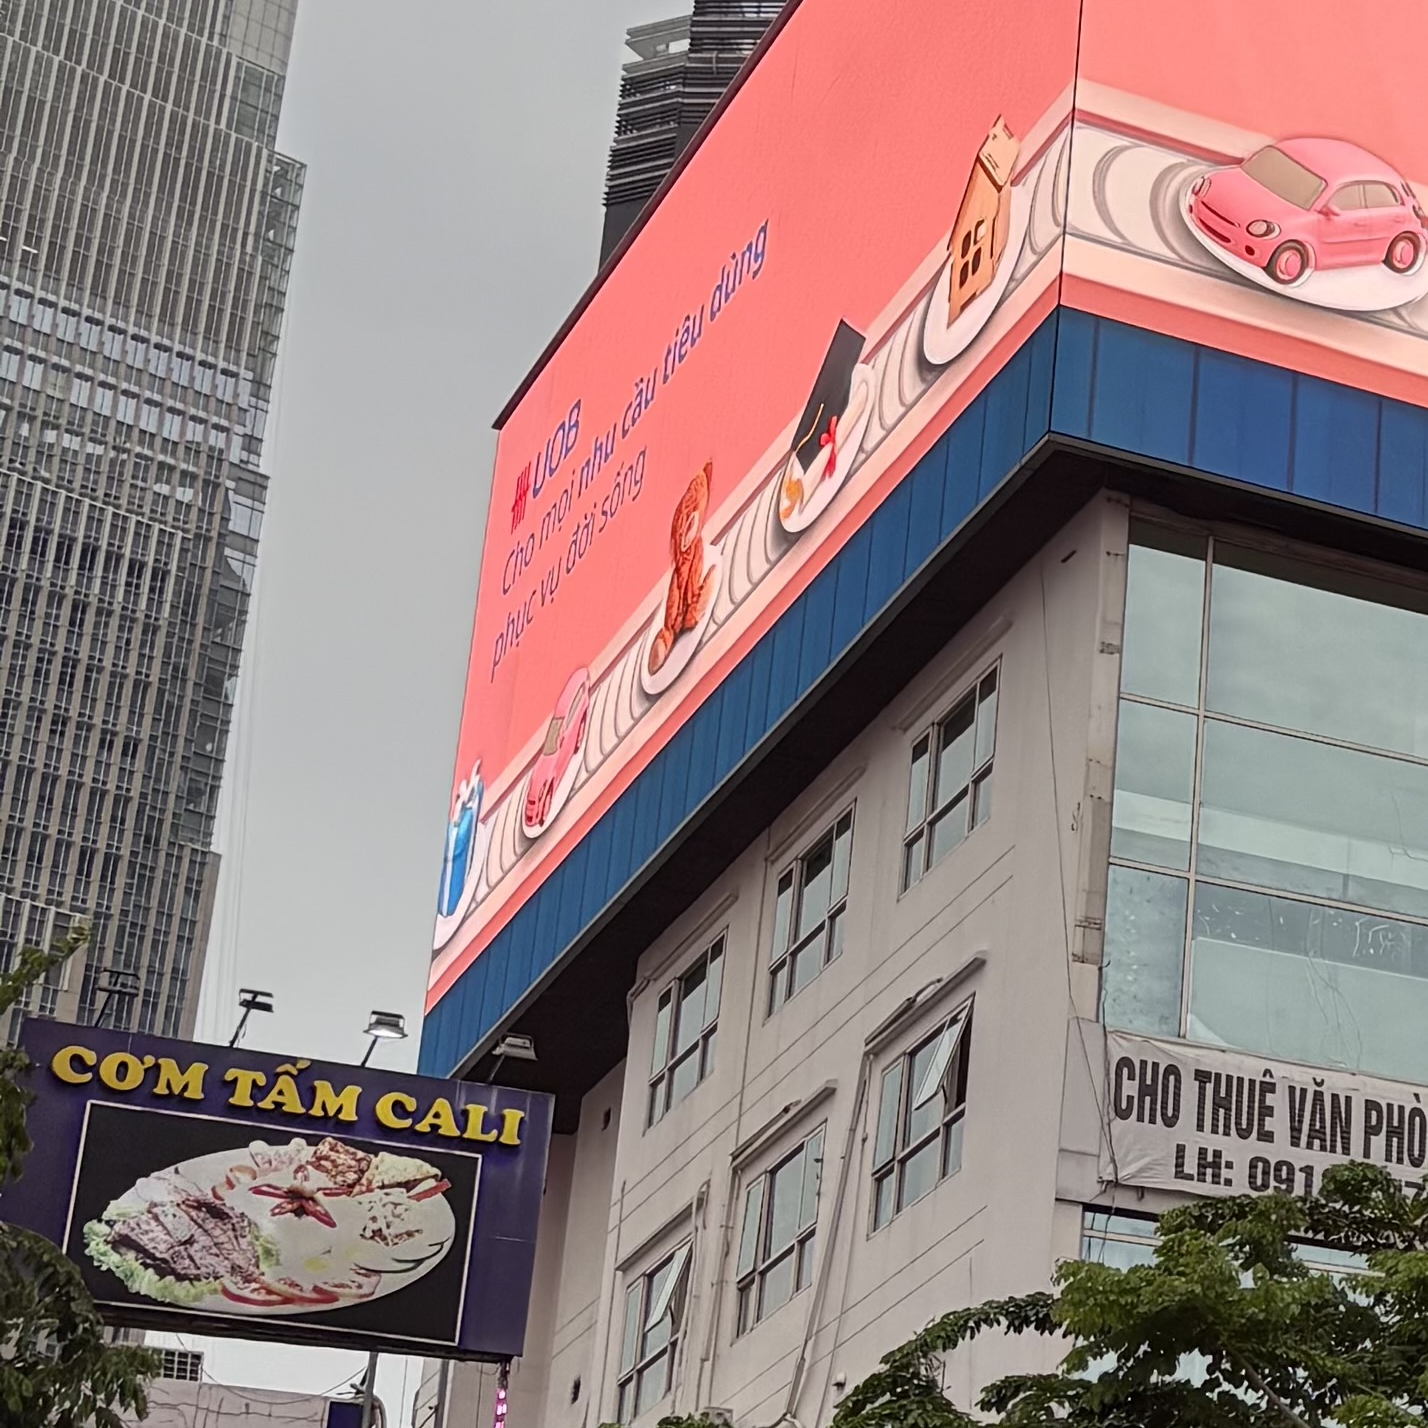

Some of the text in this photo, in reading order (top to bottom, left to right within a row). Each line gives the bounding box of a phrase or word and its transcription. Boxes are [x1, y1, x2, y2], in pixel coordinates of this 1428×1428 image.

[502, 219, 770, 597] Cho mọi nhu cầu tiêu dùng
[532, 398, 582, 496] UOB
[490, 589, 536, 684] phục
[537, 561, 562, 603] vụ
[597, 446, 648, 535] sống
[50, 1043, 527, 1147] CƠM TẤM CALI
[1113, 1055, 1181, 1129] CHO
[1193, 1068, 1277, 1144] THUÊ
[1287, 1076, 1352, 1157] VĂN
